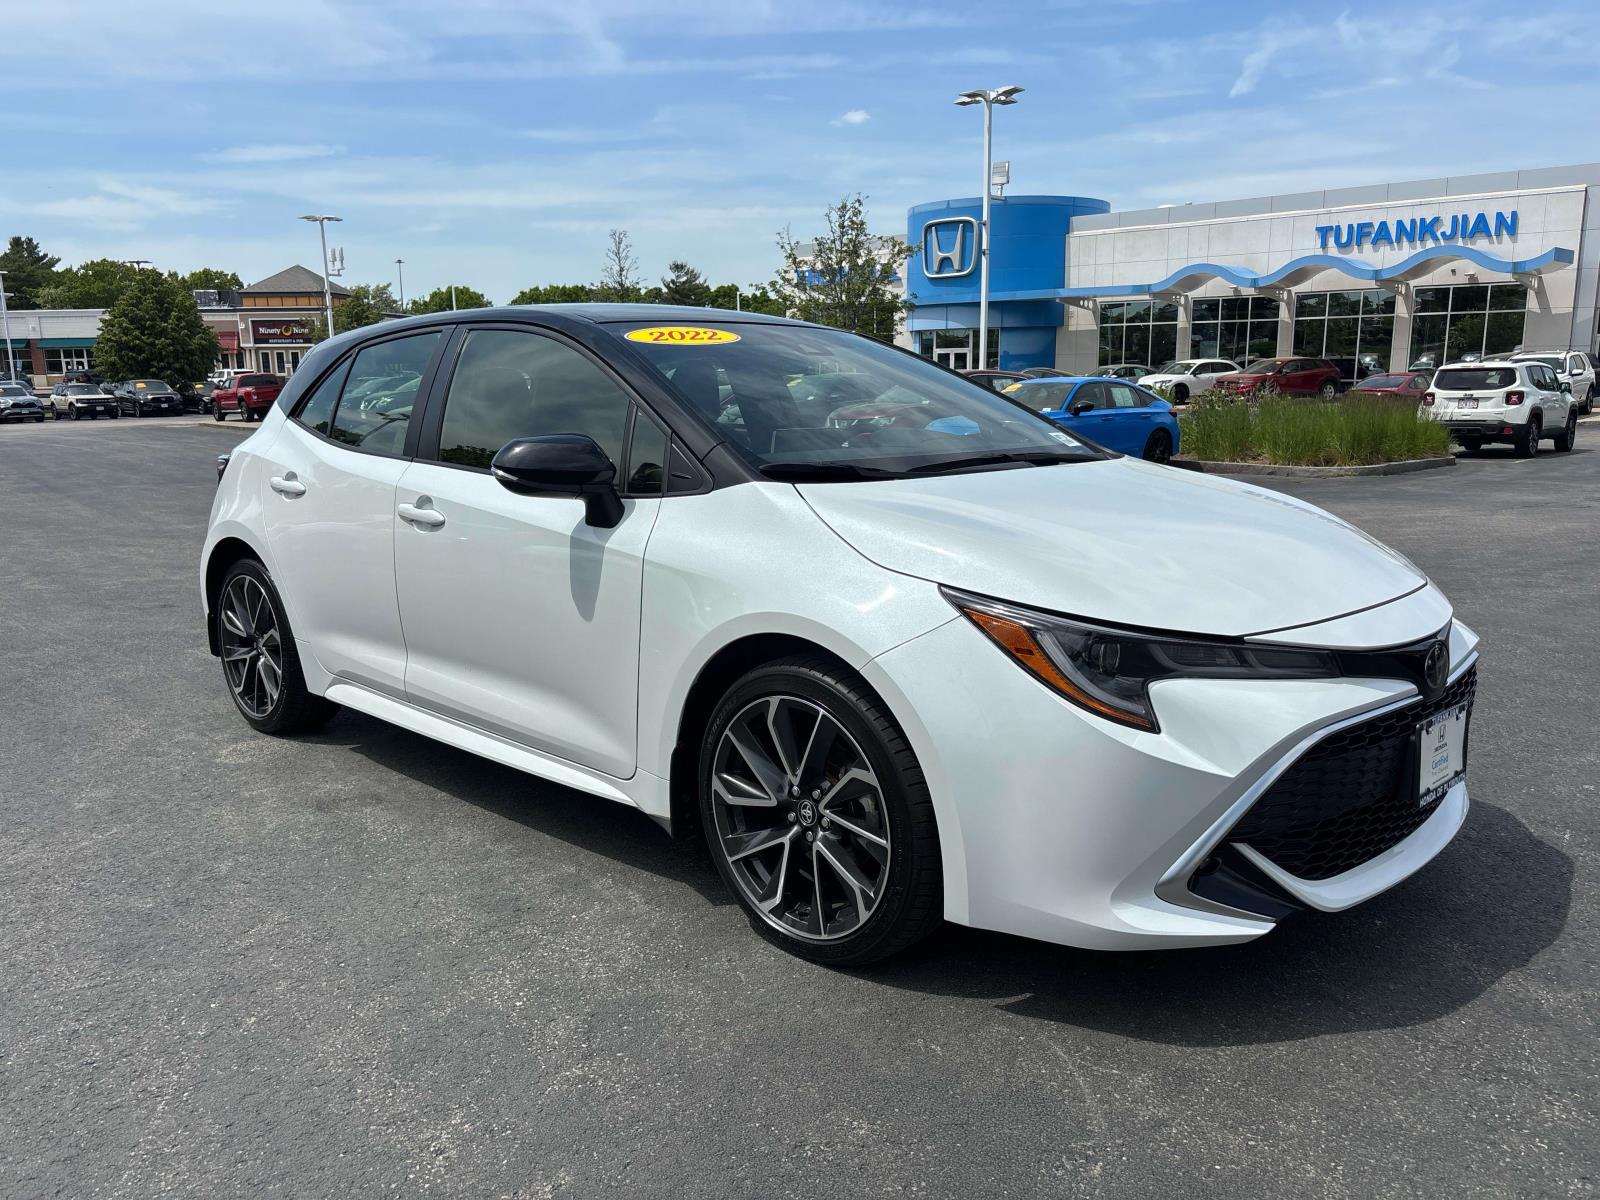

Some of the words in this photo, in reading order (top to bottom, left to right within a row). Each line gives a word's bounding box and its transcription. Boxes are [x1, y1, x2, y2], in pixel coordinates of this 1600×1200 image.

[1315, 210, 1519, 249] TUFANKJIAN
[259, 327, 281, 335] Ninety
[649, 330, 722, 341] 2022
[1420, 790, 1436, 809] HONDA
